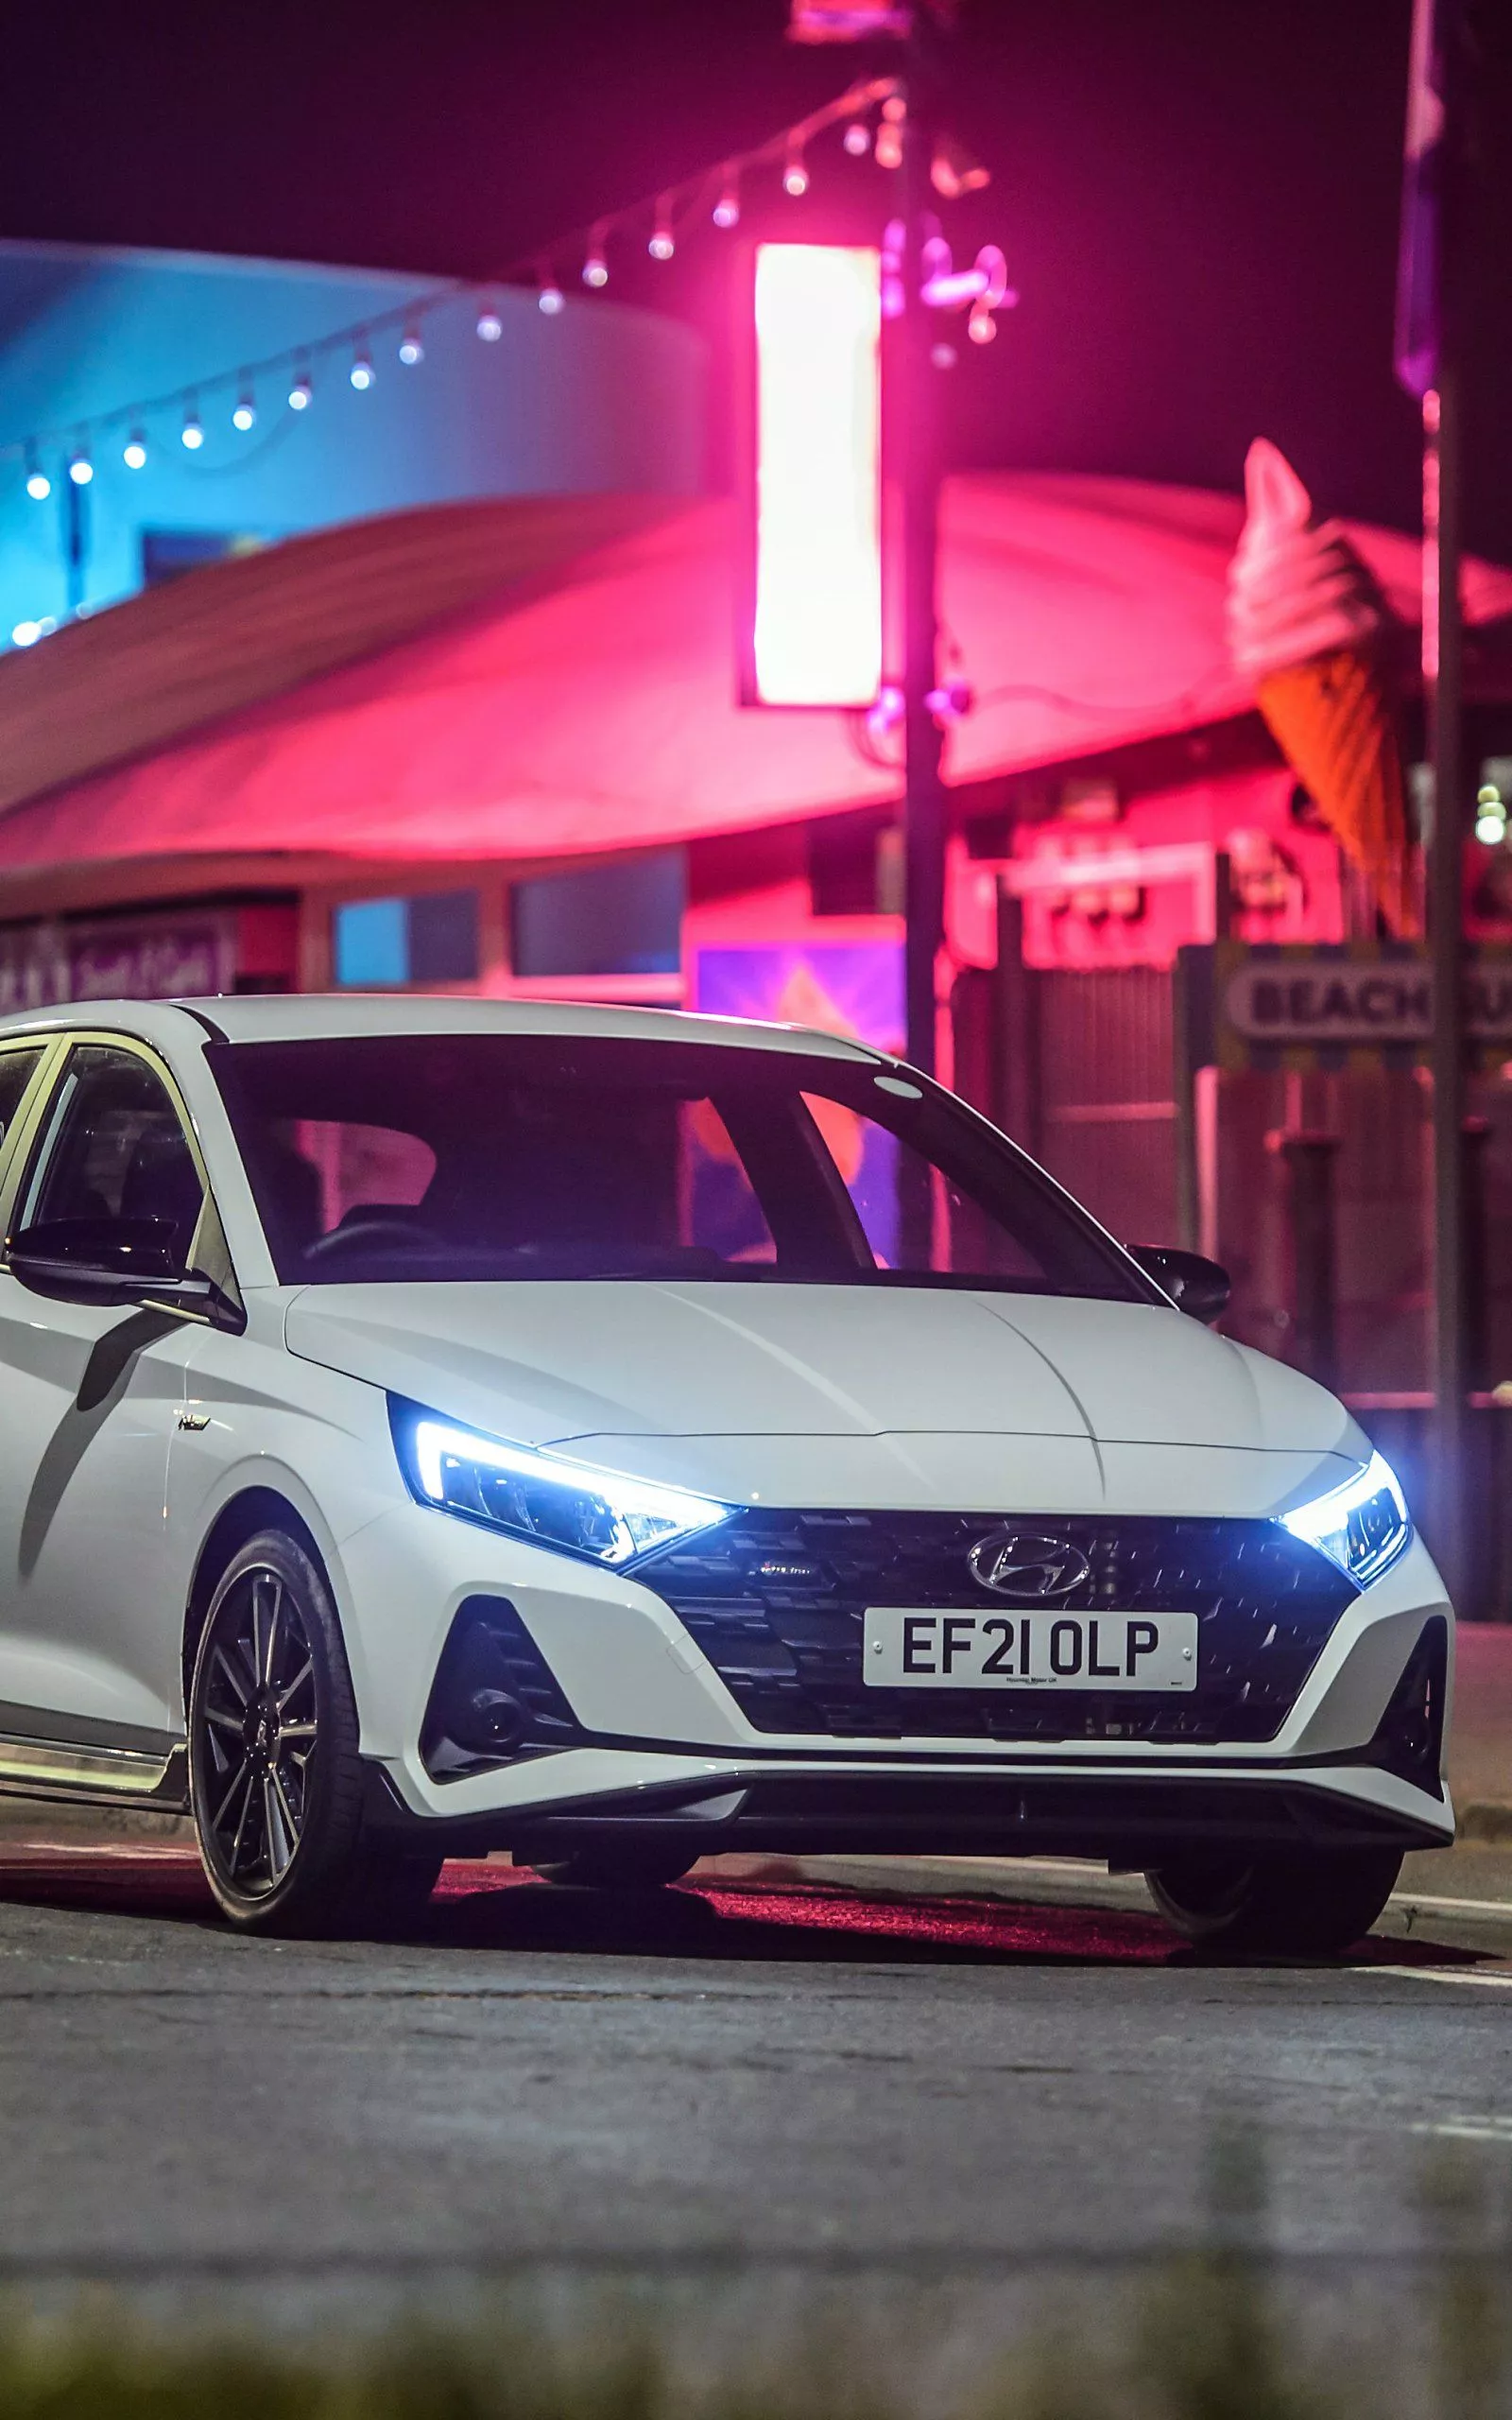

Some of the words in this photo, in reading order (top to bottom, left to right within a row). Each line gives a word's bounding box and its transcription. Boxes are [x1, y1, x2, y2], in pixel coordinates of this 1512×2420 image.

[1251, 979, 1430, 1024] BEACH
[902, 1617, 1030, 1675] EF21
[1050, 1619, 1159, 1677] OLP
